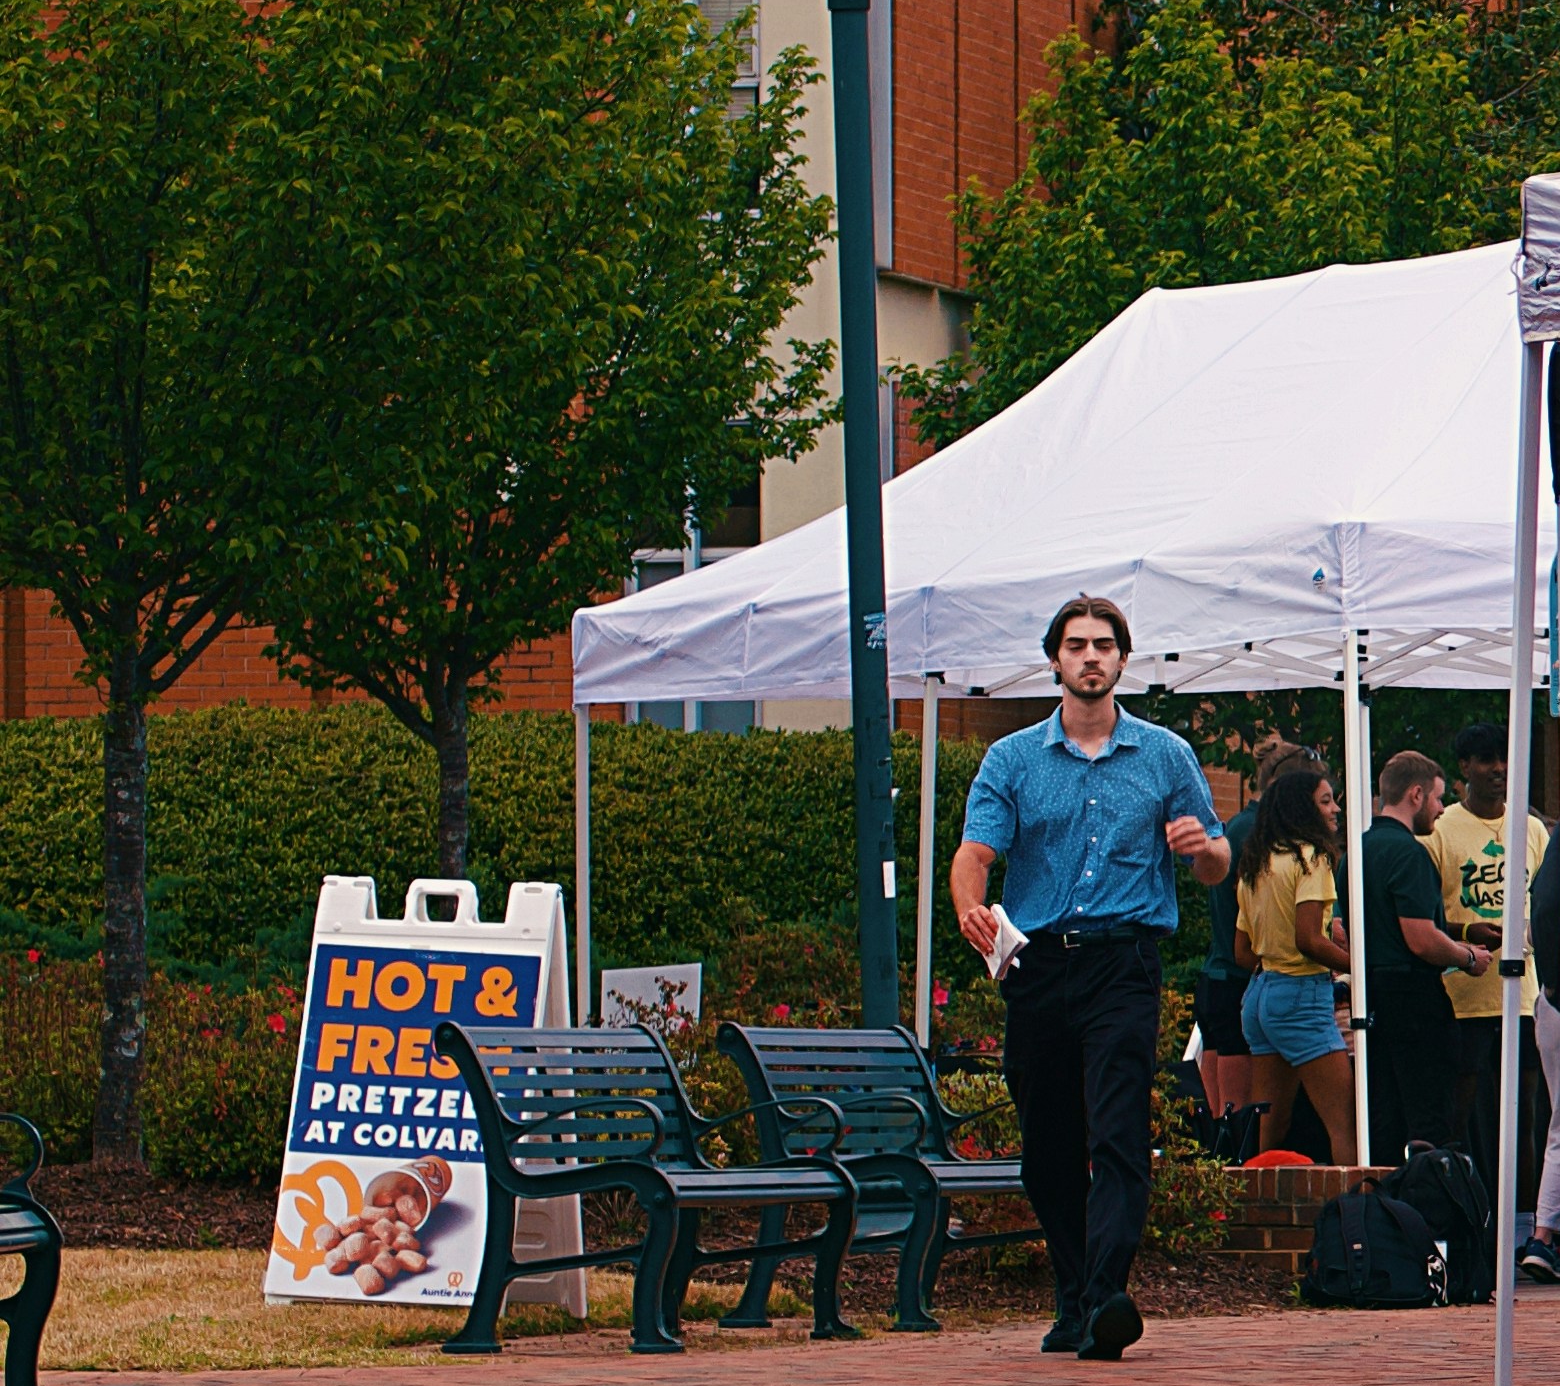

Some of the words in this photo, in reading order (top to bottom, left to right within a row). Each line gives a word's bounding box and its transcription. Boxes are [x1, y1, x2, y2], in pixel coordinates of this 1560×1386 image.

[325, 957, 468, 1014] HOT
[474, 965, 519, 1018] &
[315, 1022, 513, 1080] FRES
[303, 1119, 345, 1144] AT
[352, 1122, 483, 1153] COLVAR
[421, 1287, 452, 1297] Auntie
[454, 1289, 474, 1298] Ann
